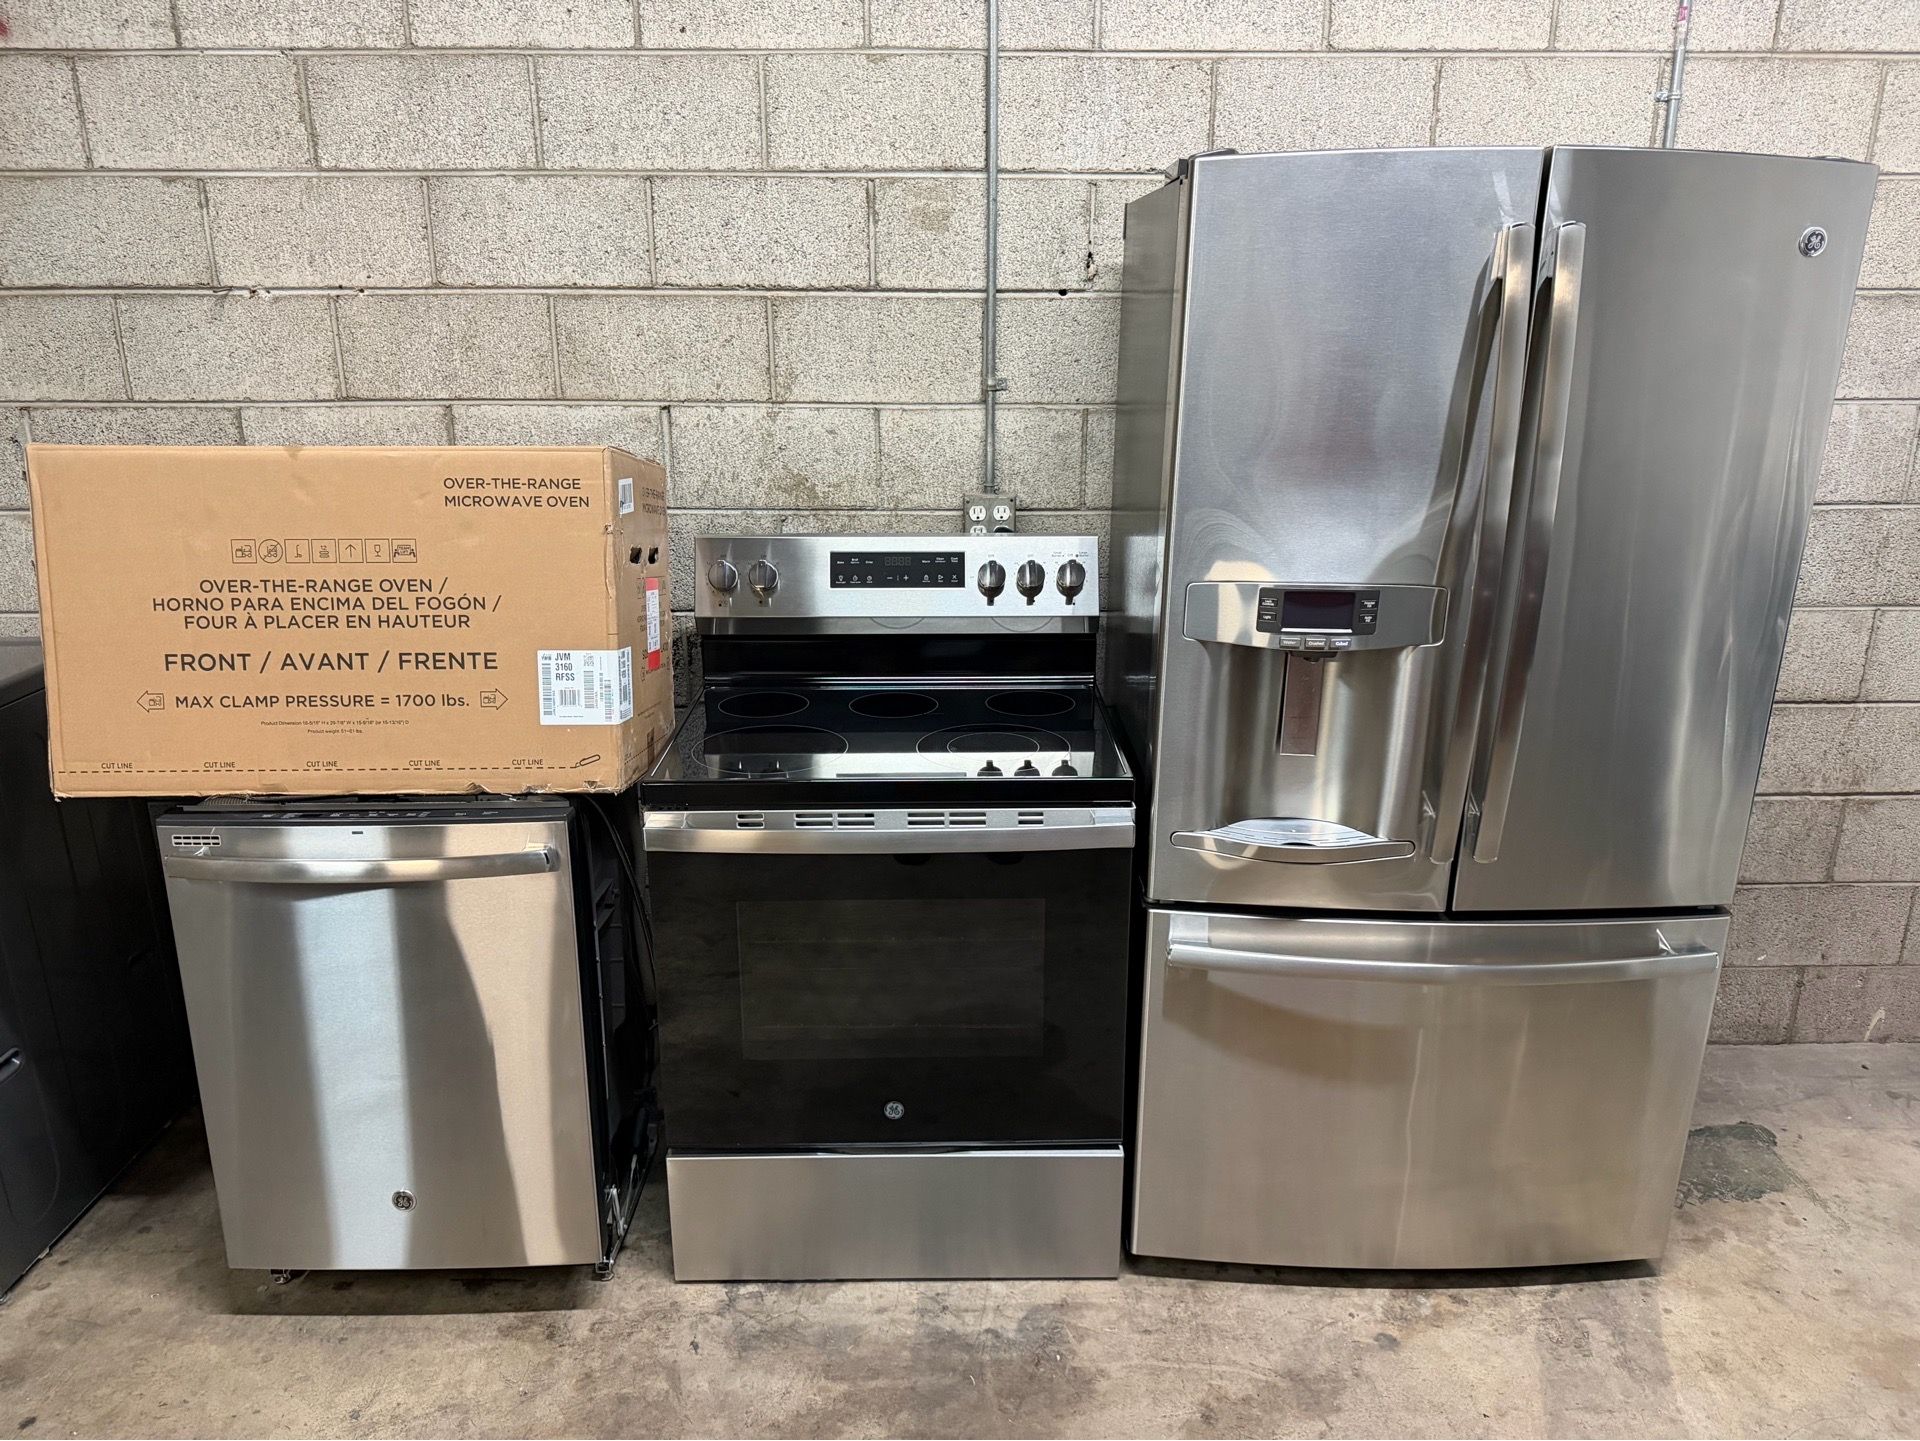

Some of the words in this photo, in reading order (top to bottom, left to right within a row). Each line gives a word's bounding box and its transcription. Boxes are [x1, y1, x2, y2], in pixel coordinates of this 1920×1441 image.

[443, 477, 582, 490] OVER-THE-RANGE
[444, 495, 543, 508] MICROWAVE
[546, 495, 590, 508] OVEN
[199, 578, 374, 594] OVER-THE-RANGE
[378, 578, 433, 593] OVEN
[152, 597, 224, 612] HORNO
[230, 597, 285, 612] PARA
[290, 596, 365, 611] ENCIMA
[371, 596, 410, 611] DEL
[415, 592, 487, 611] FOGÓN
[183, 615, 238, 630] FOUR
[243, 611, 257, 629] À
[263, 614, 340, 629] PLACER
[345, 614, 372, 629] EN
[377, 614, 471, 629] HAUTEUR
[164, 652, 252, 672] FRONT
[279, 652, 369, 671] AVANT
[398, 651, 499, 671] FRENTE
[555, 652, 571, 661] JVM
[555, 662, 573, 672] 3160
[555, 672, 575, 682] RFSS
[175, 695, 215, 709] MAX
[219, 695, 280, 709] CLAMP
[285, 694, 376, 708] PRESSURE
[395, 694, 436, 707] 1700
[441, 693, 470, 707] lbs.
[100, 762, 116, 770] CUT
[116, 762, 133, 770] LINE
[203, 762, 219, 770] CUT
[219, 762, 236, 770] LINE
[305, 761, 321, 769] CUT
[321, 761, 338, 769] LINE
[408, 760, 424, 768] CUT
[424, 760, 441, 768] LINE
[511, 759, 527, 767] CUT
[527, 759, 544, 767] LINE
